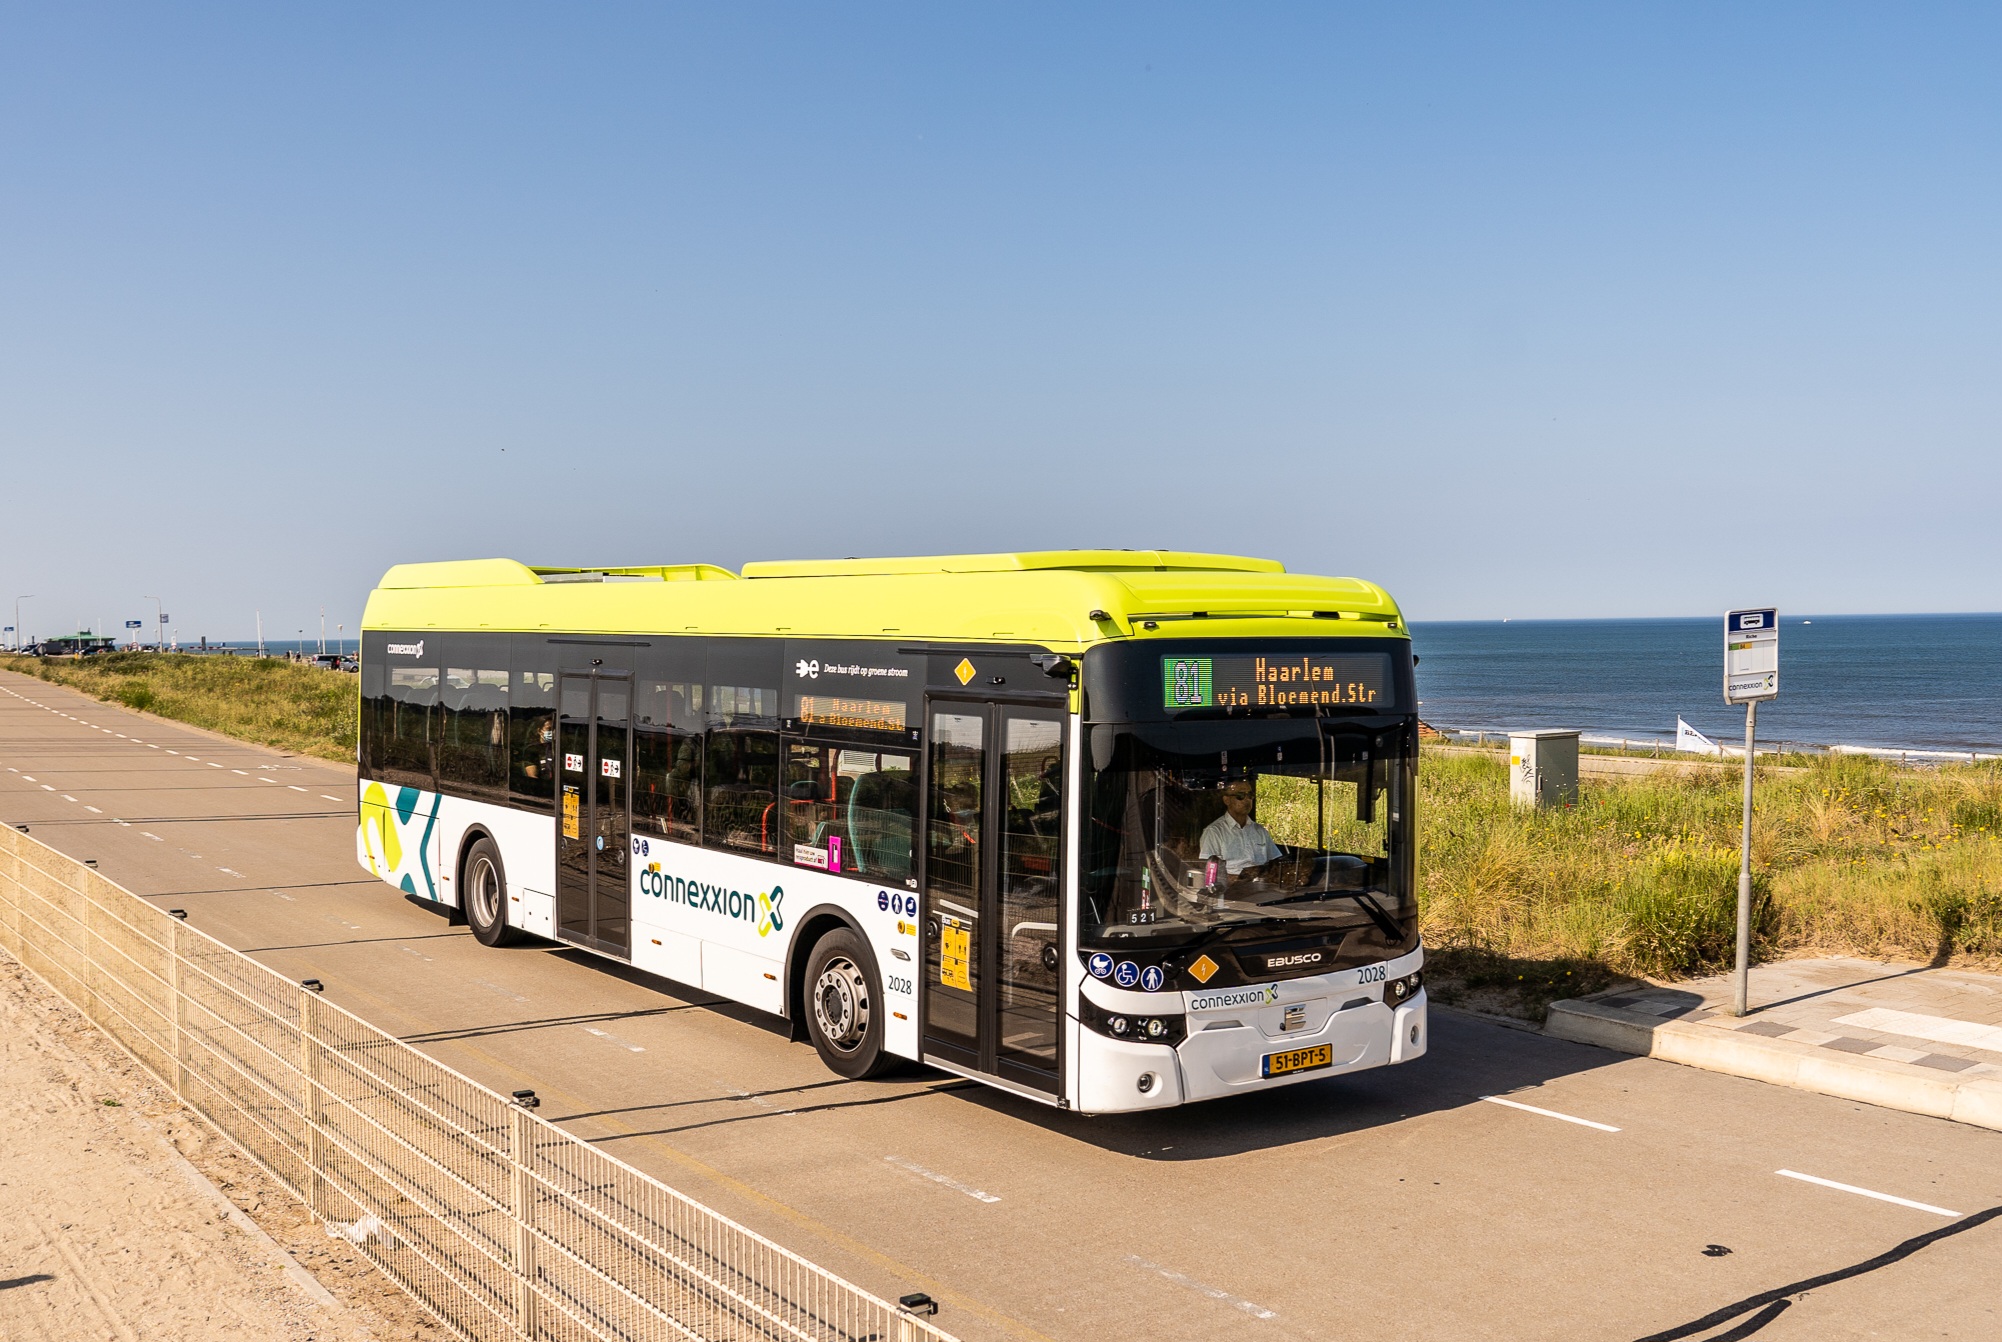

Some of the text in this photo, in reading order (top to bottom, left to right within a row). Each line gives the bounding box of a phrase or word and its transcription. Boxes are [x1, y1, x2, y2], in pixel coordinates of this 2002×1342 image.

[823, 663, 908, 677] Deze bus rijdt op groene stroom
[1255, 657, 1334, 682] Haarlem
[1174, 660, 1203, 705] 81
[1729, 681, 1763, 691] connexxion
[1217, 683, 1377, 706] via Bloemend.Str
[832, 698, 891, 715] Haarlem
[640, 868, 755, 923] connexxion
[1267, 952, 1322, 968] EBUSCO
[888, 975, 912, 995] 2028
[1357, 965, 1386, 985] 2028
[1191, 989, 1264, 1011] connexxion
[1275, 1048, 1327, 1071] 51-BPT-5
